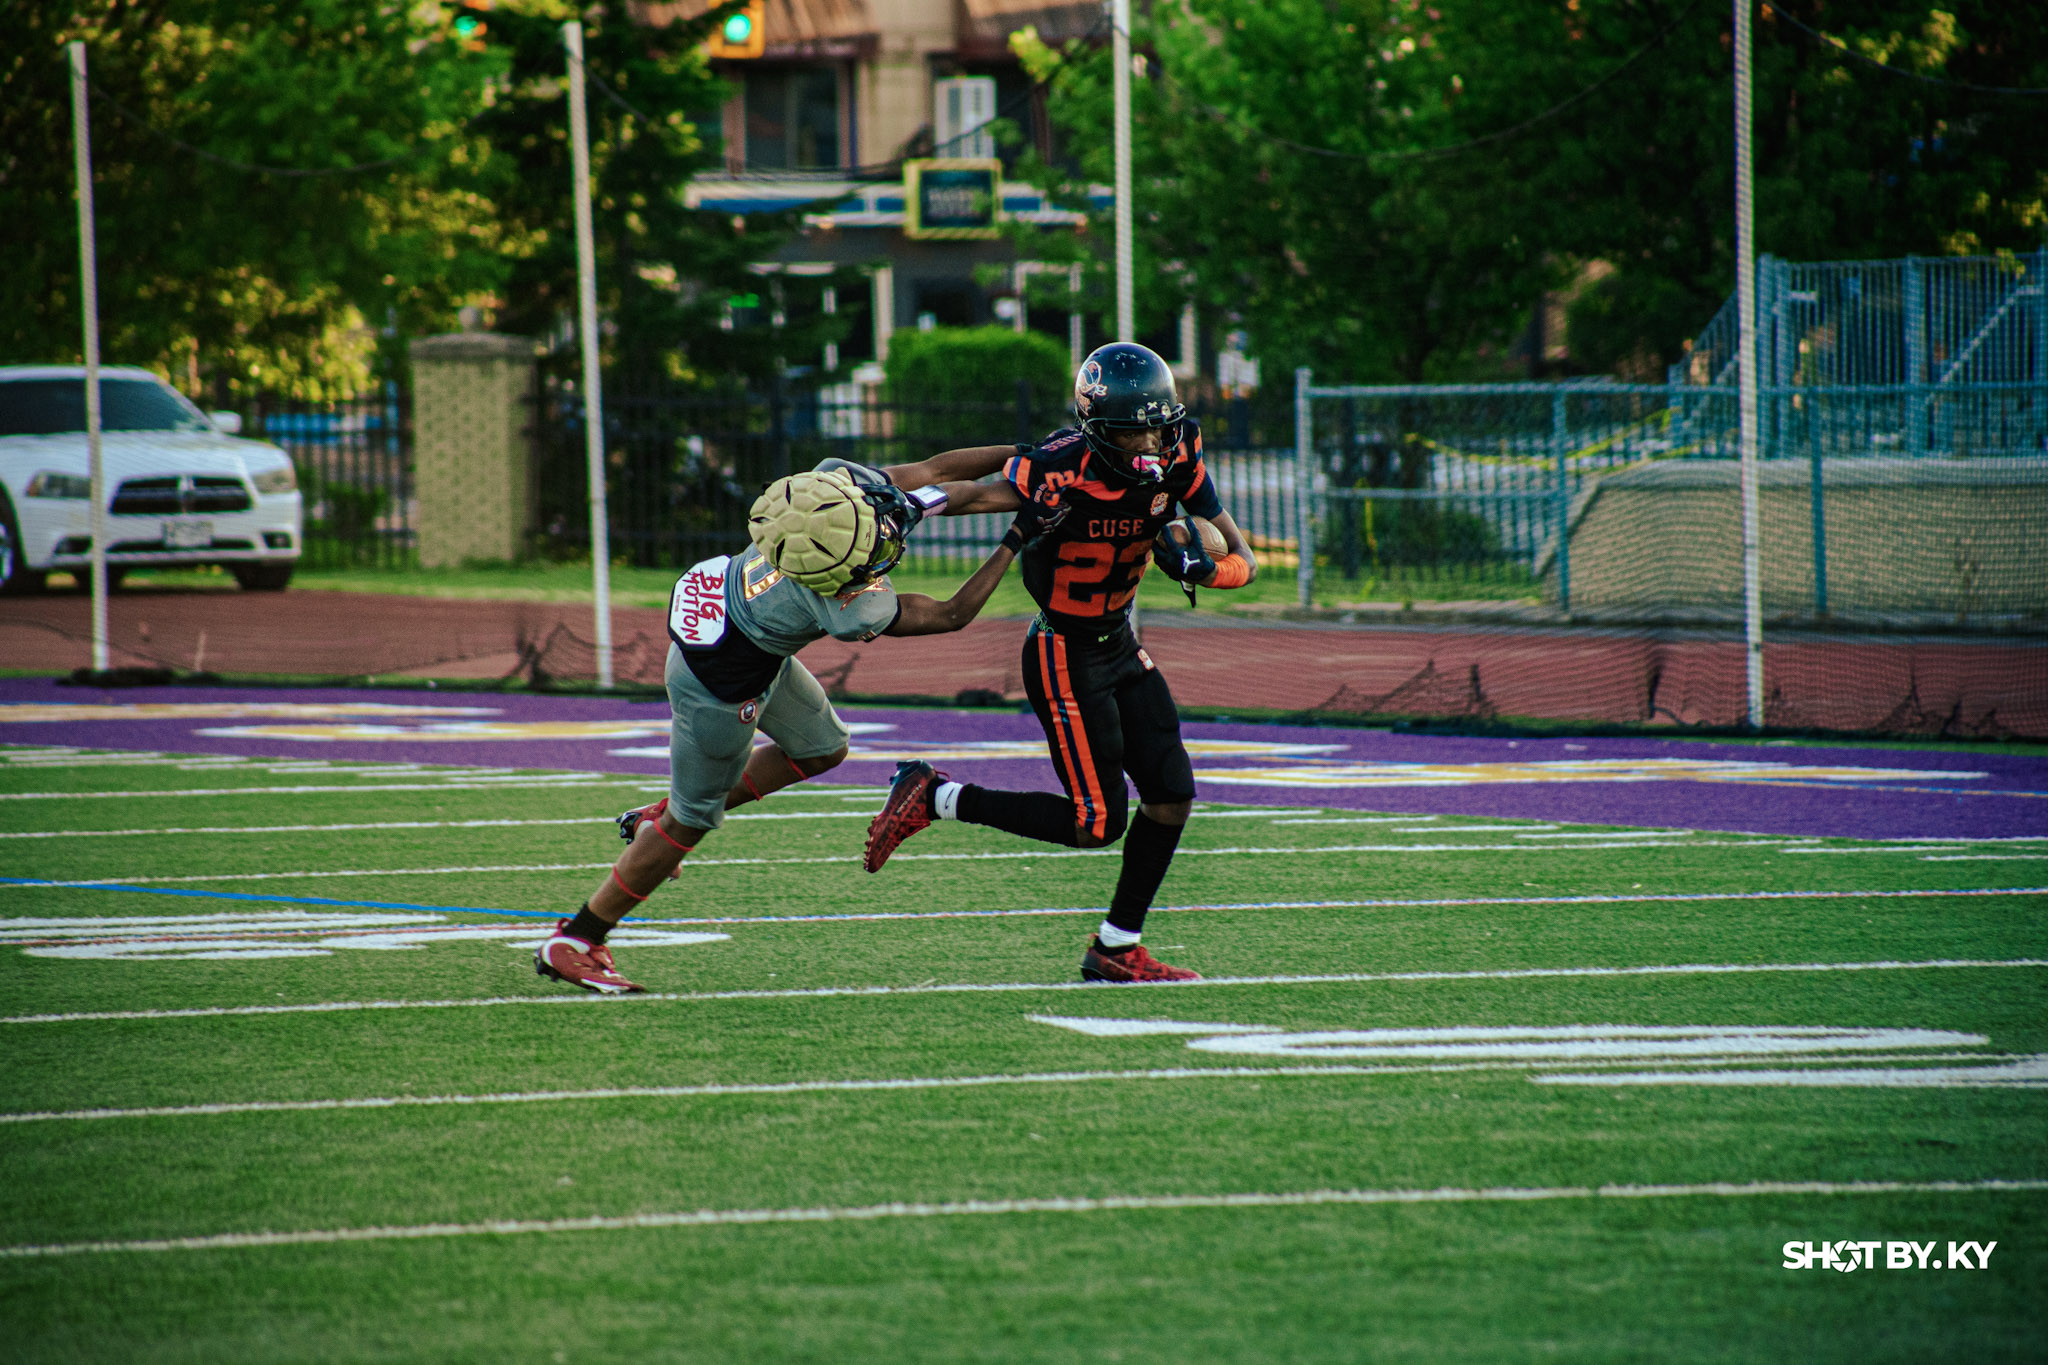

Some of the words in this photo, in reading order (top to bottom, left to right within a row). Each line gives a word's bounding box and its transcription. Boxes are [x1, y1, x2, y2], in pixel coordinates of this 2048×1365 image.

[1088, 518, 1144, 538] CUSE
[681, 571, 703, 641] MOTION
[698, 568, 725, 623] BIG
